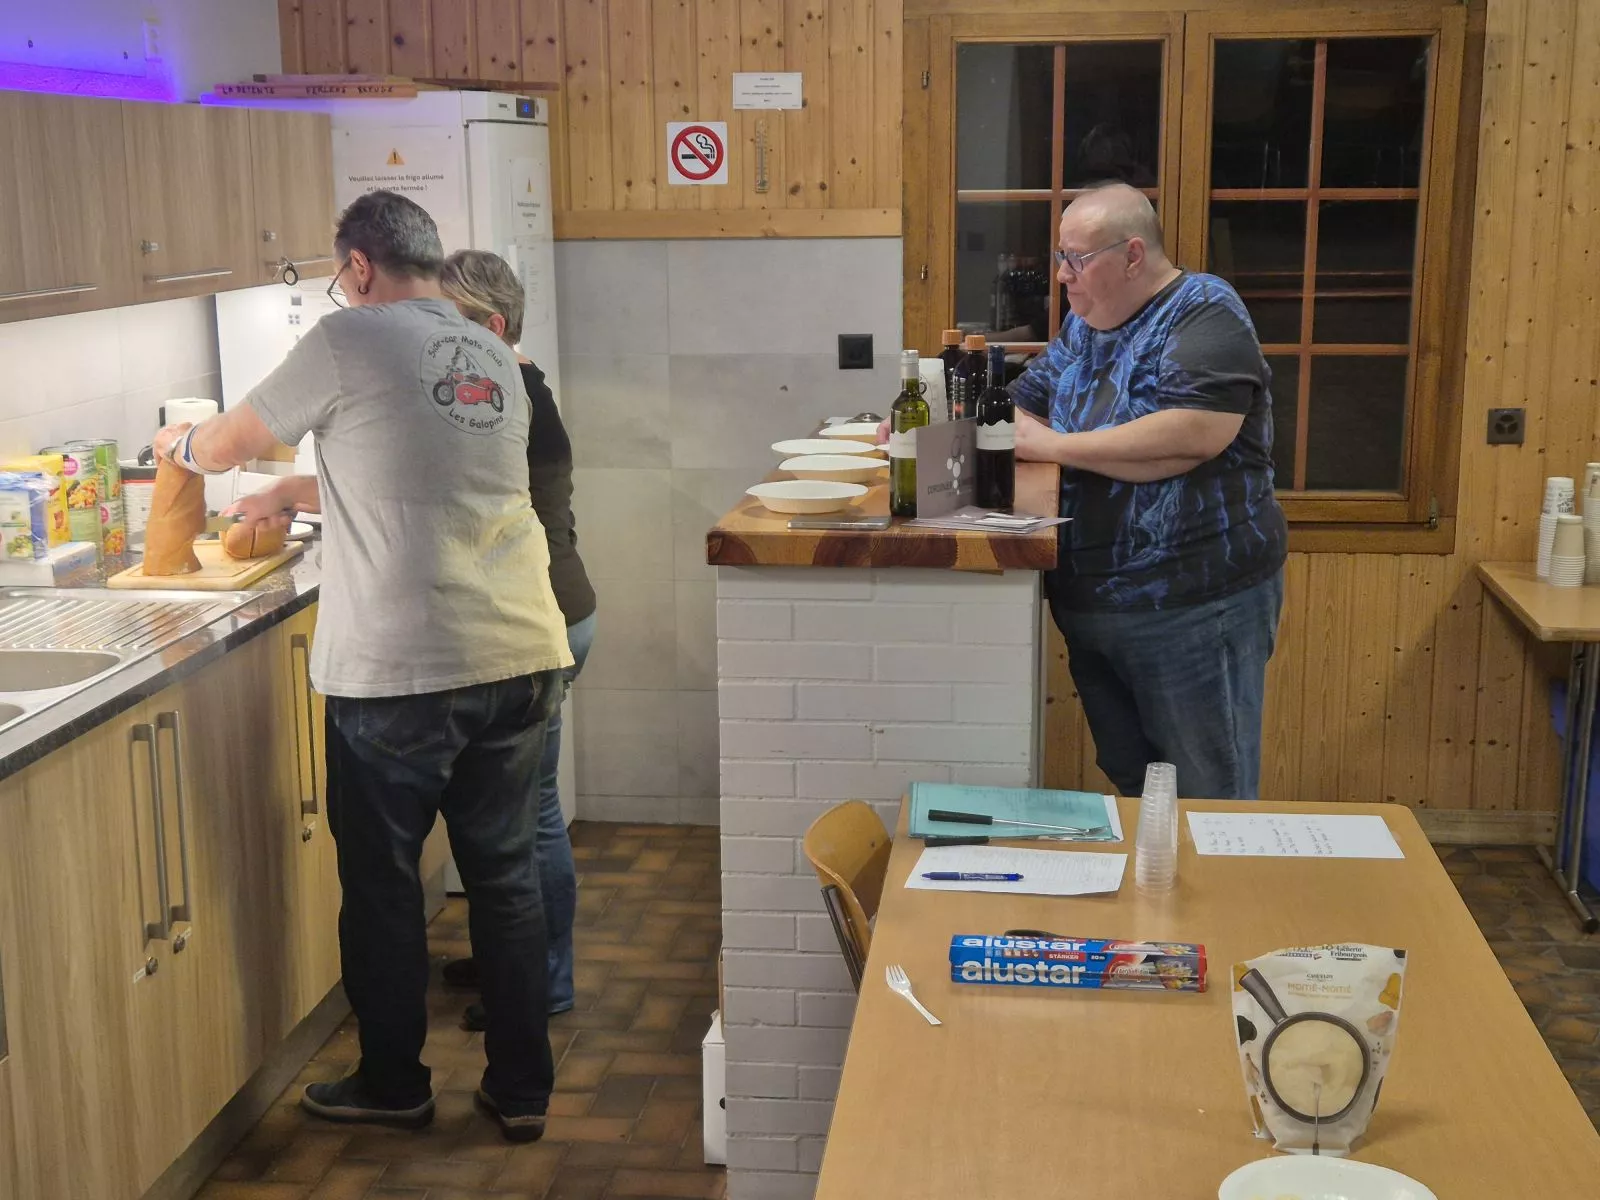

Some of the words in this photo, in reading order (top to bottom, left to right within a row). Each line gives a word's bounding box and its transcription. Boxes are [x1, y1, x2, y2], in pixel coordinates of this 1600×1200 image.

[405, 174, 421, 182] frigo
[428, 336, 458, 359] Side-car
[461, 335, 483, 350] Moto
[486, 348, 503, 367] Club
[449, 408, 466, 424] Les
[469, 415, 504, 430] Galopins
[962, 937, 1087, 951] alustar
[1330, 950, 1368, 959] Fribourgeois
[961, 957, 1087, 985] alustar
